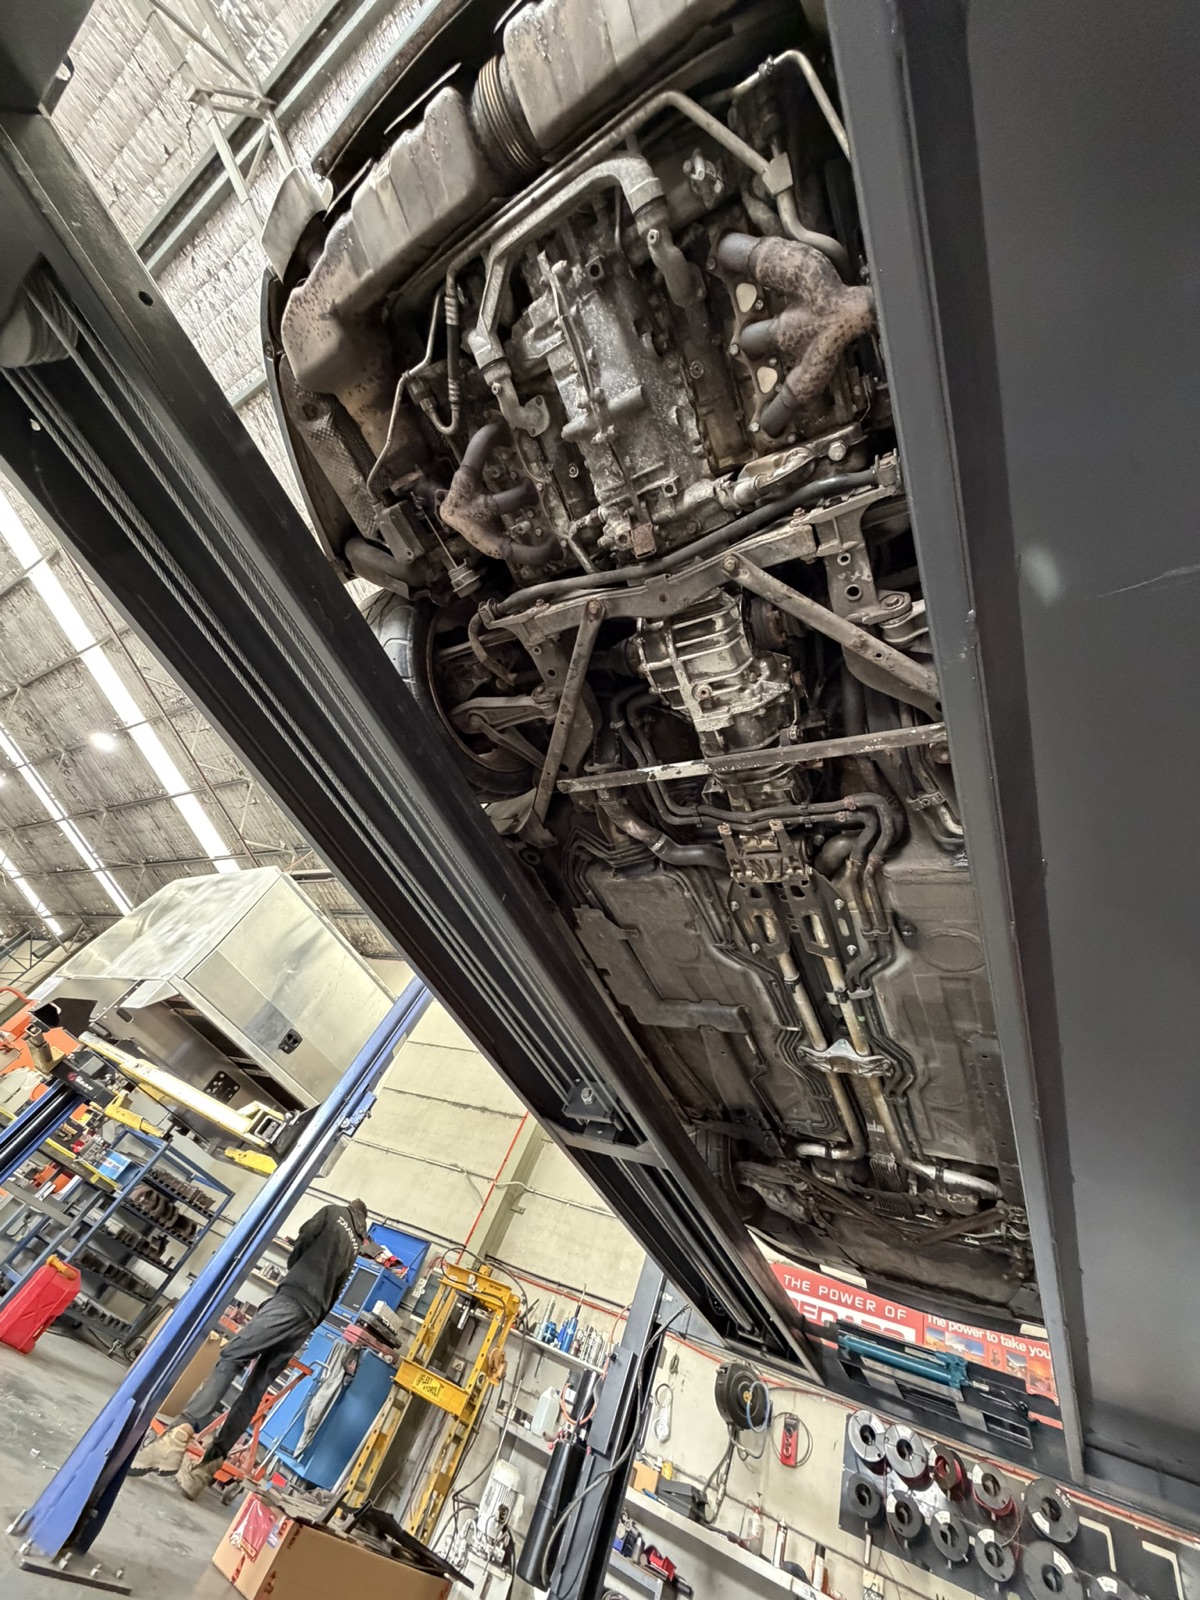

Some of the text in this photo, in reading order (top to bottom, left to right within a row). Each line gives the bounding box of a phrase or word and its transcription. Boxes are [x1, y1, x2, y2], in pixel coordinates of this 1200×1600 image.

[783, 1274, 811, 1293] THE
[818, 1285, 877, 1313] POWER
[884, 1305, 907, 1320] OF
[927, 1314, 947, 1328] The
[948, 1321, 985, 1339] power
[986, 1330, 999, 1344] to
[1000, 1334, 1027, 1352] take
